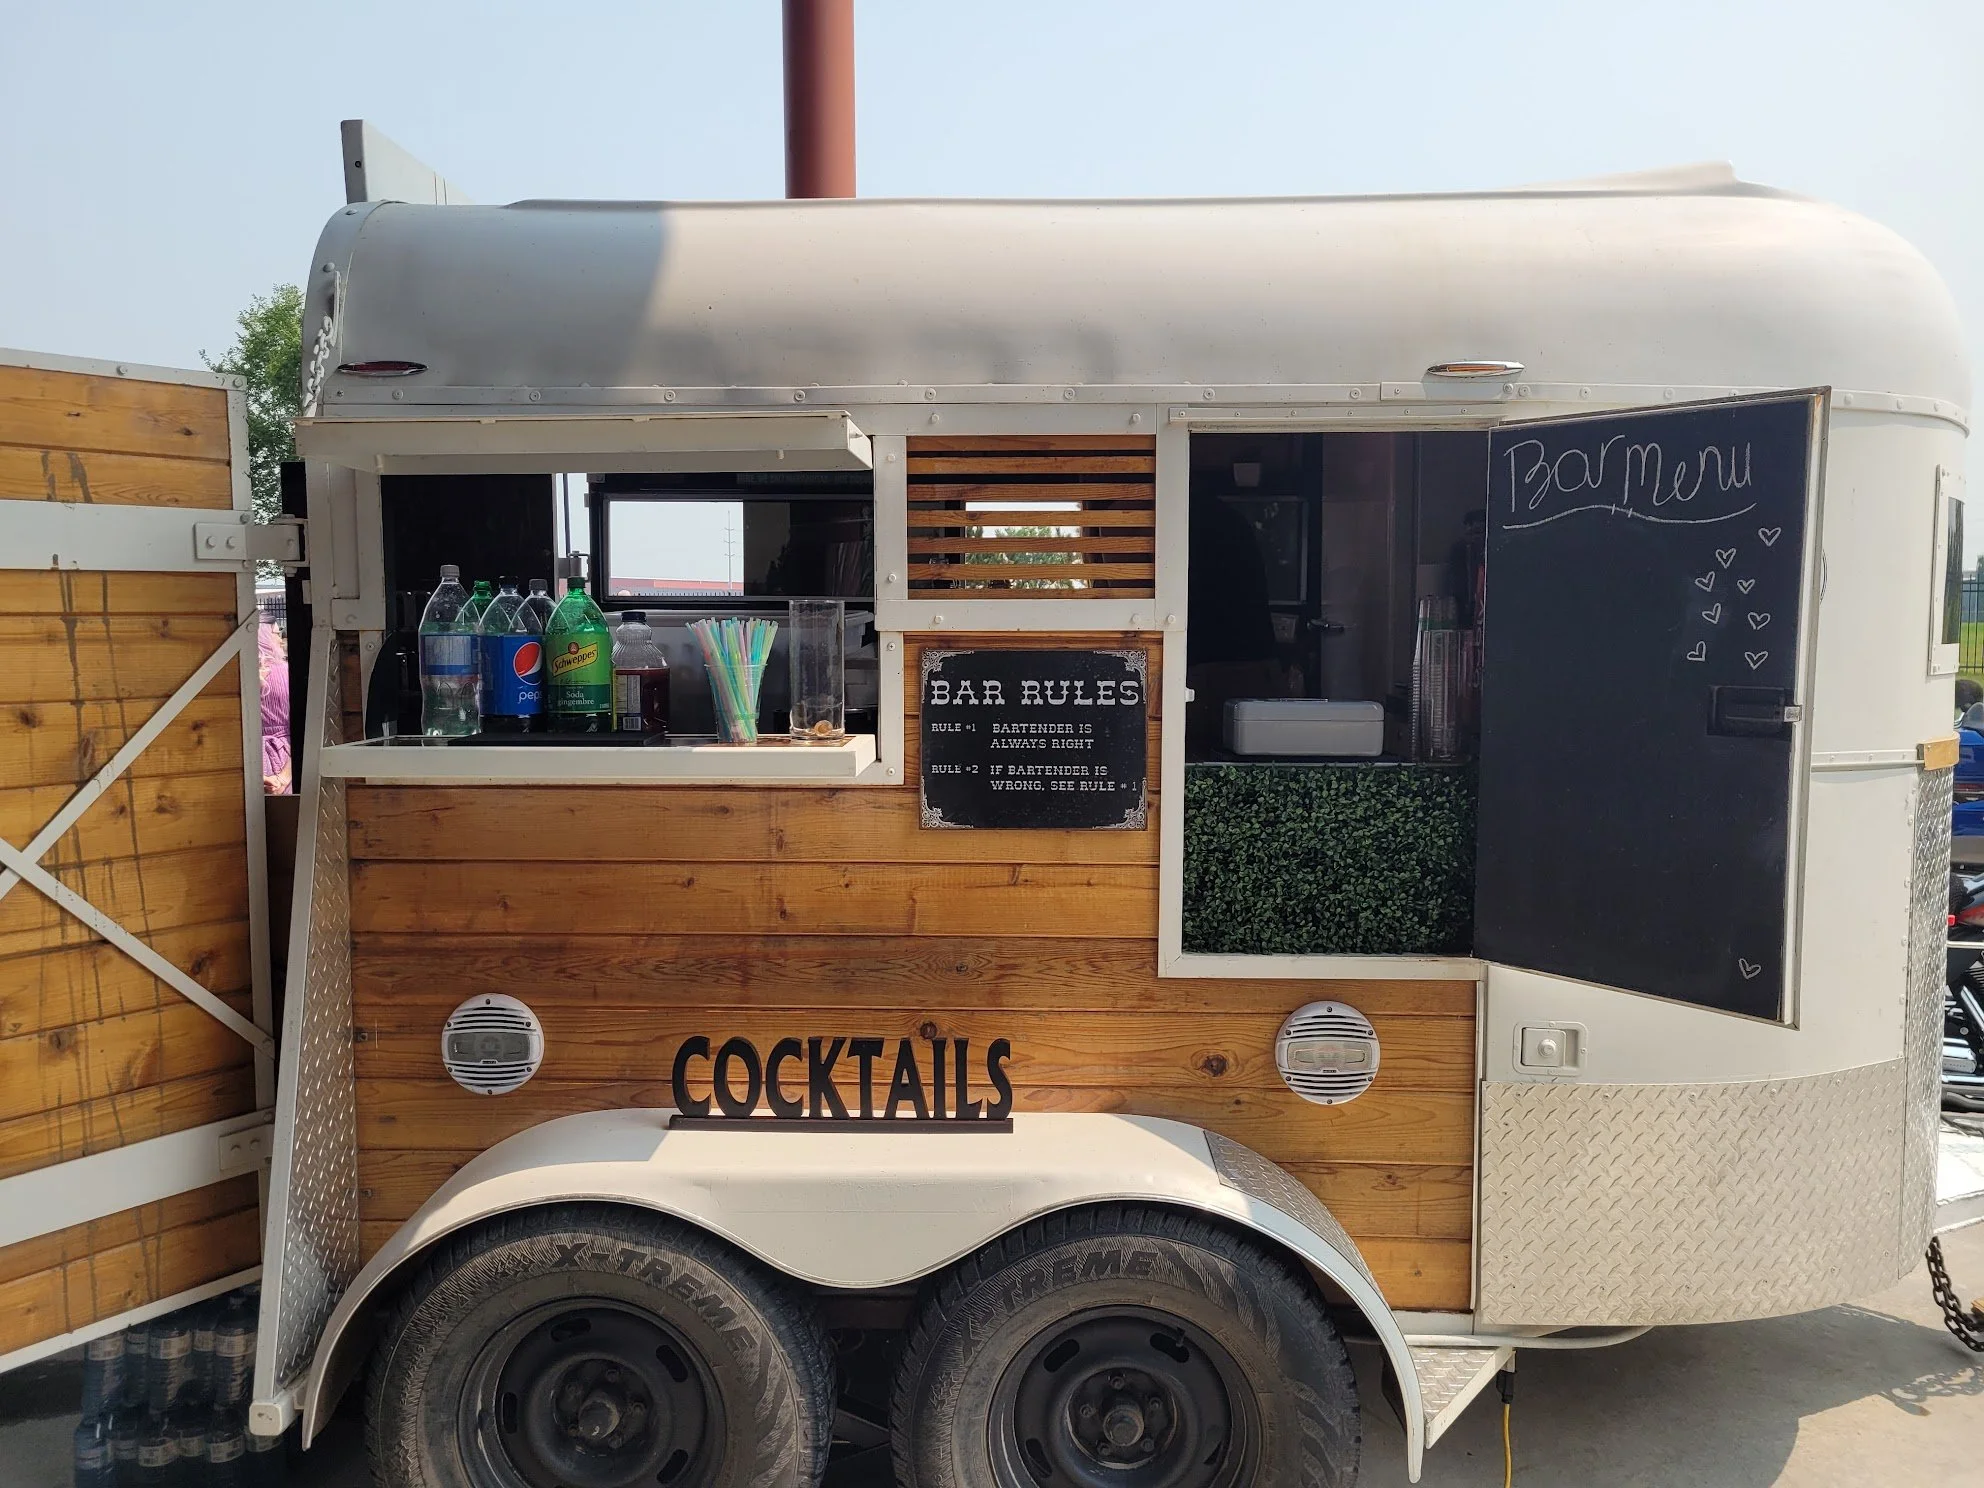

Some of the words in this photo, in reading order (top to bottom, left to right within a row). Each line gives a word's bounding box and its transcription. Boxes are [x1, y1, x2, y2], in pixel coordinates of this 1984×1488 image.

[1504, 434, 1625, 512] Bar
[554, 649, 597, 673] Schweppes
[566, 690, 585, 698] Soda
[930, 679, 1006, 706] BAR
[1020, 680, 1139, 706] RULES
[931, 723, 962, 732] RULE
[965, 723, 977, 732] #1
[992, 723, 1074, 734] BARTENDER
[1078, 723, 1093, 734] IS
[990, 738, 1047, 749] ALWAYS
[1051, 738, 1095, 749] RIGHT
[931, 764, 962, 774] RULE
[965, 764, 979, 774] #2
[990, 765, 1004, 775] IF
[1007, 765, 1090, 776] BARTENDER
[1094, 765, 1109, 776] IS
[1050, 780, 1075, 791] SEE
[1079, 781, 1116, 791] RULE
[671, 1035, 1014, 1121] COCKTAILS
[552, 1242, 758, 1352] X-TREME
